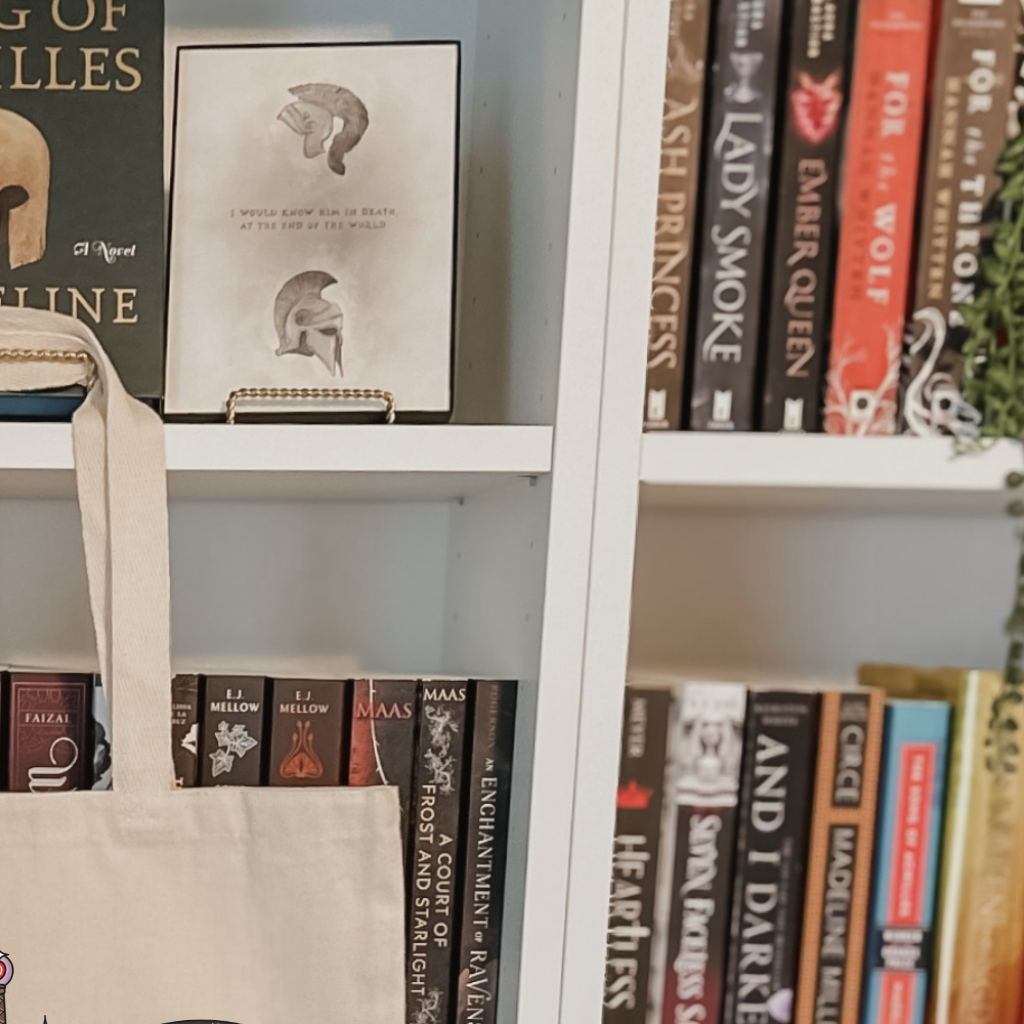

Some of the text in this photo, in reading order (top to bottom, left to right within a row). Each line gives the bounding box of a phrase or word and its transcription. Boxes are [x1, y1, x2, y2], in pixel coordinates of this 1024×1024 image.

[51, 0, 126, 31] OF
[966, 48, 997, 115] FOR
[880, 71, 910, 138] FOR
[239, 208, 277, 218] WOULD
[239, 222, 253, 231] AT
[348, 221, 387, 230] WORLD
[645, 98, 699, 371] ASH PRINCESS
[702, 112, 764, 365] LADY SMOKE
[92, 240, 137, 264] Novel
[866, 202, 898, 307] WOLF
[783, 158, 829, 378] EMBER QUEEN
[210, 701, 260, 713] MELLOW
[226, 689, 245, 700] E.J.
[279, 703, 330, 714] MELLOW
[423, 688, 467, 701] MAAS
[25, 713, 70, 723] FAIZAL
[356, 702, 413, 719] MAAS
[484, 757, 495, 771] AN
[834, 724, 865, 804] CIRCE
[750, 734, 789, 833] AND
[473, 776, 498, 930] ENCHANTMENT
[748, 849, 780, 865] I
[411, 784, 436, 996] FROST AND STARLIGHT
[433, 834, 454, 949] A COURT OF
[473, 930, 484, 944] OF
[604, 834, 652, 1011] HEARTLESS
